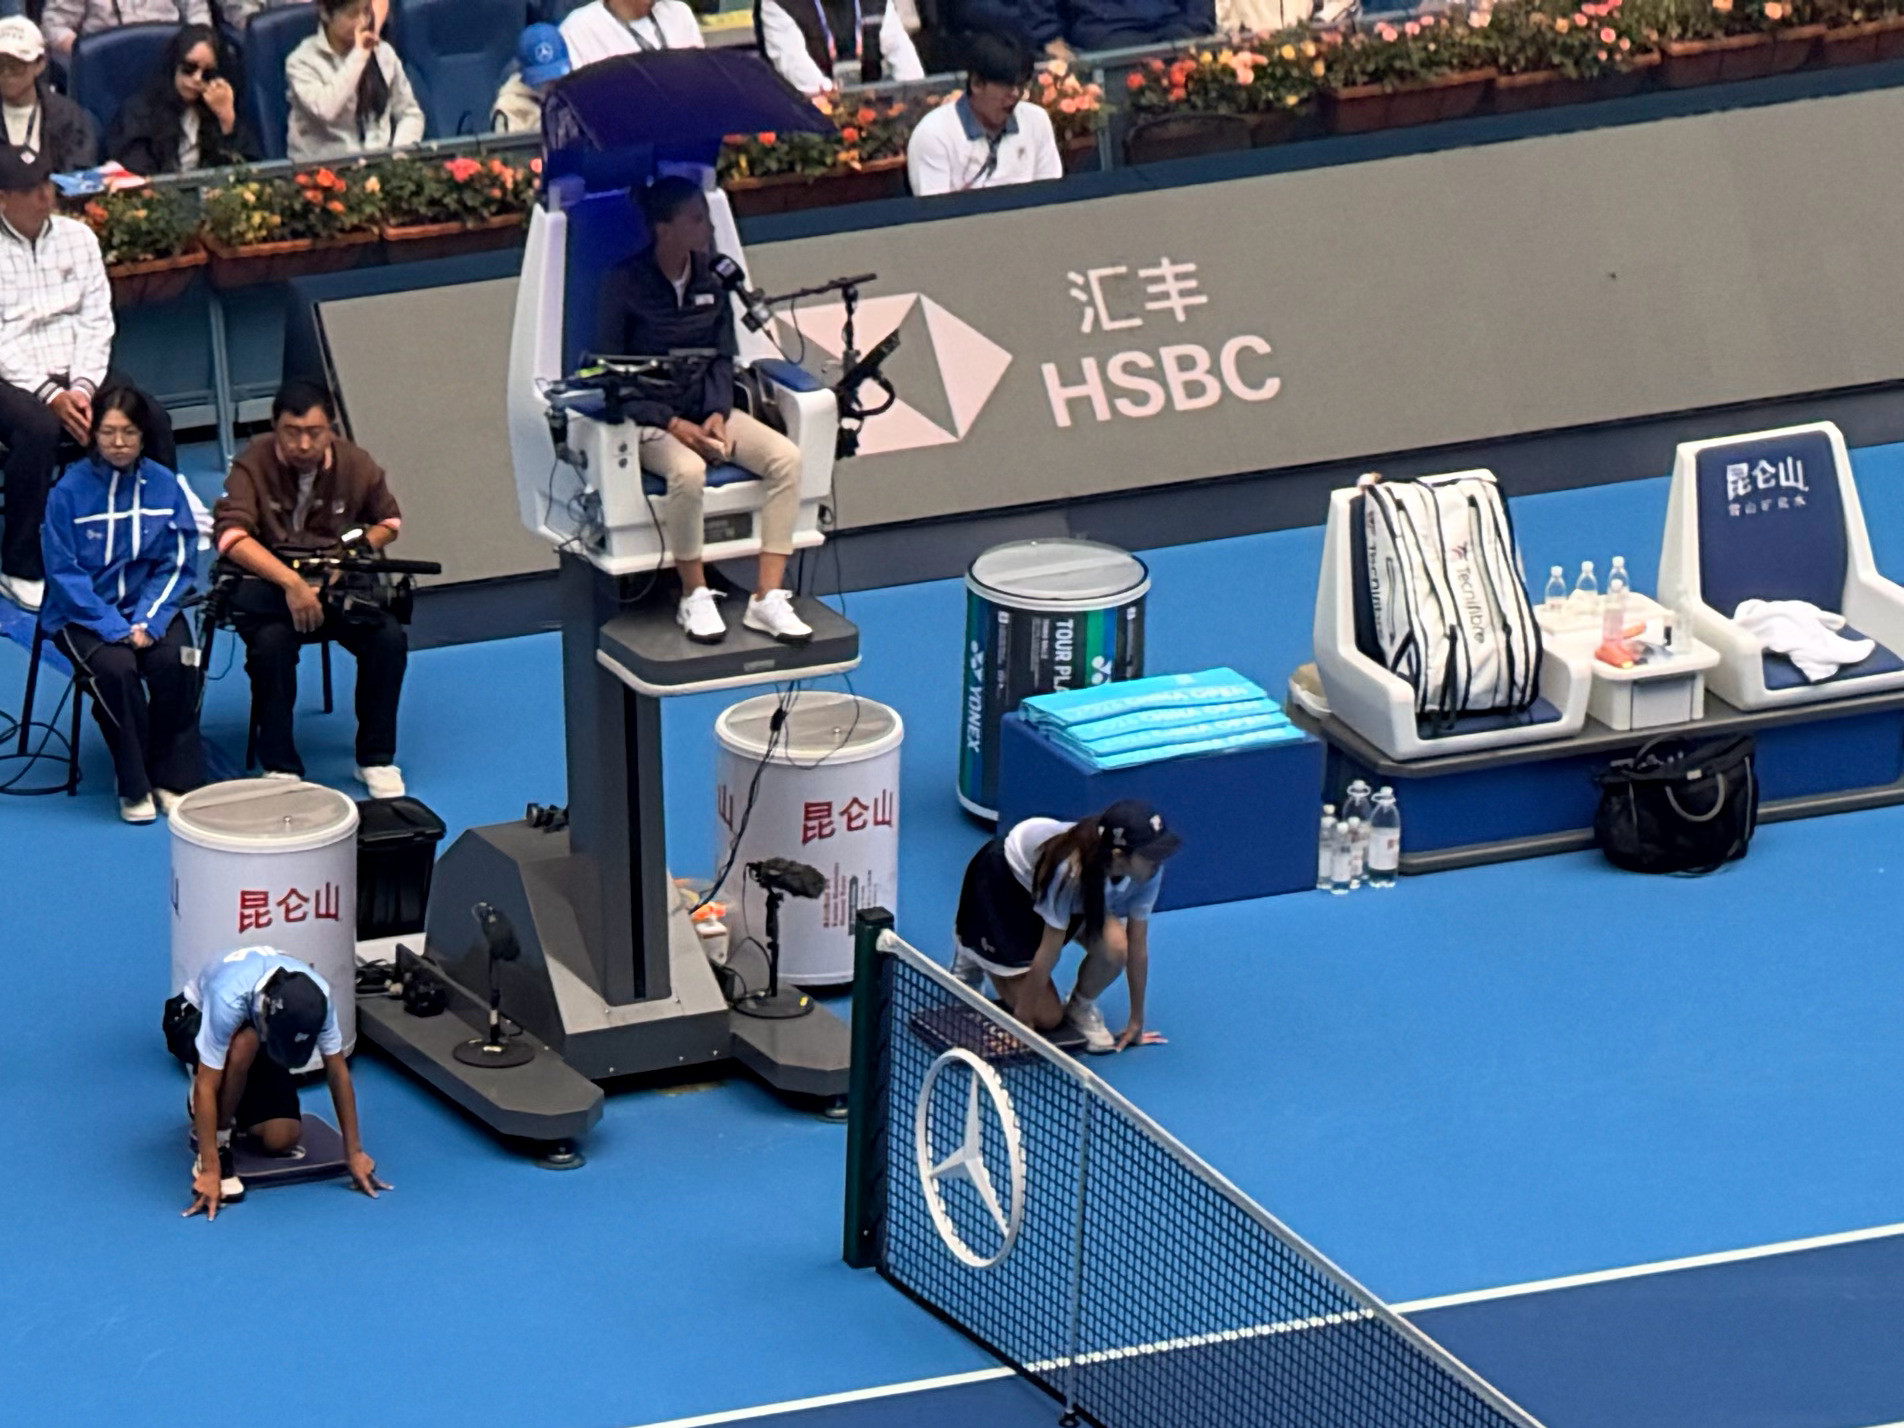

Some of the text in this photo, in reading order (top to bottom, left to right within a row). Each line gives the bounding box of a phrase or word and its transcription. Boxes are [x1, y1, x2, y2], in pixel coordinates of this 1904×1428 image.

[1067, 257, 1208, 333] 汇丰
[1041, 335, 1281, 427] HSBC
[1726, 456, 1809, 500] 昆仑山
[1456, 567, 1485, 644] Tecnifibre
[1054, 618, 1074, 662] TOUR
[967, 685, 983, 753] YONEX
[801, 788, 893, 846] 昆仑山
[238, 882, 341, 934] 昆仑山
